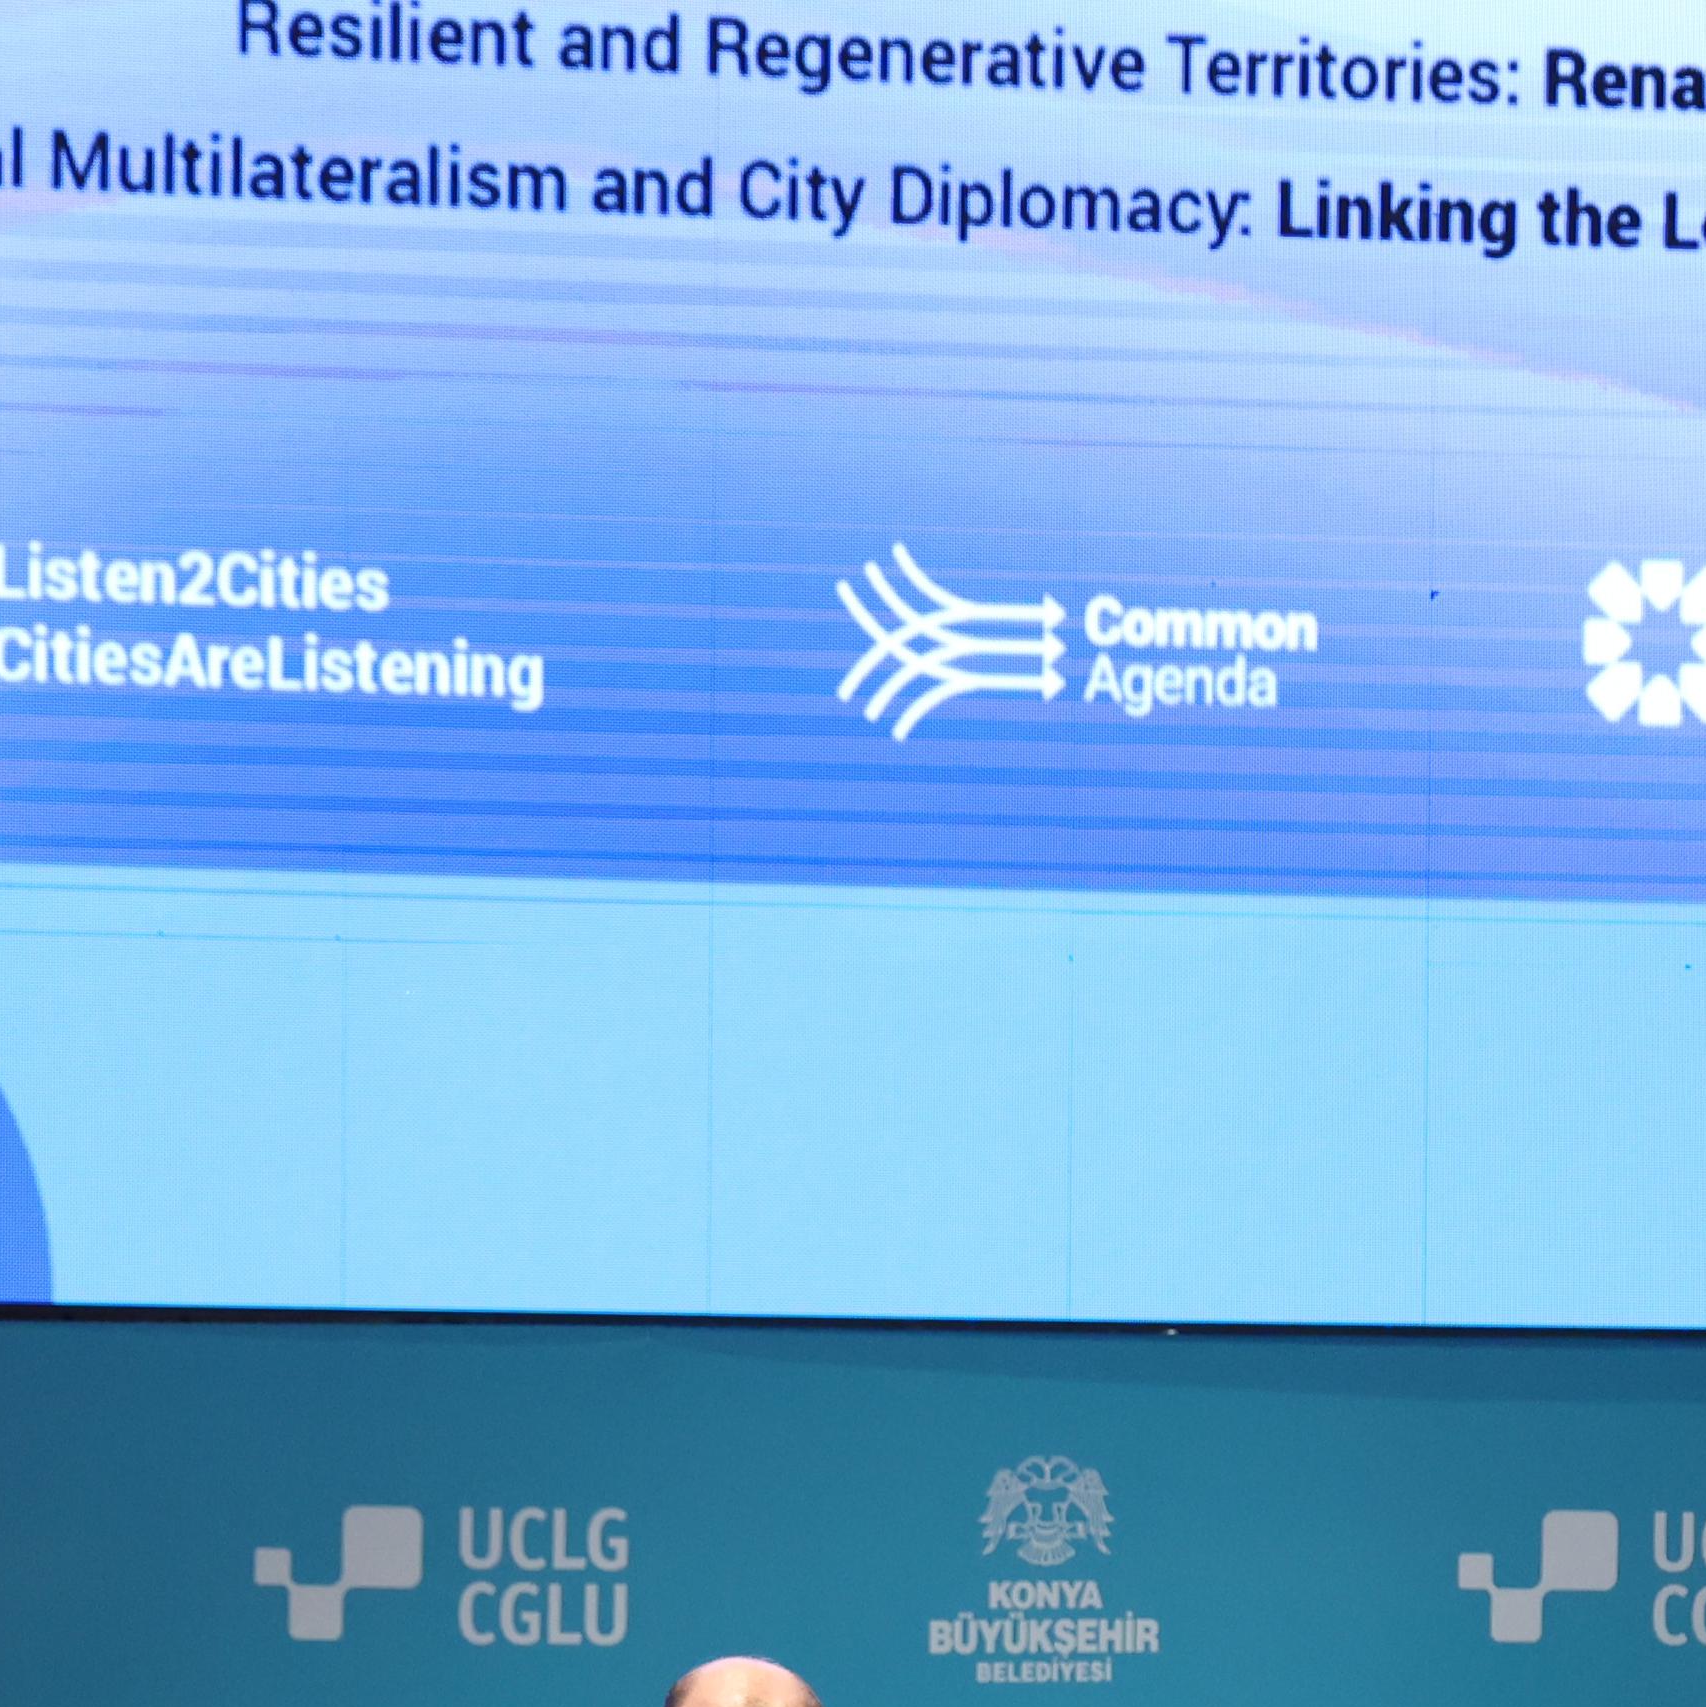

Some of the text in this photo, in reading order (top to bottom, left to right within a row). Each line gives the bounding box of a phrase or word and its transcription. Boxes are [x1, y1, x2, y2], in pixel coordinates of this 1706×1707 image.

[238, 0, 535, 69] Resilient
[557, 11, 681, 76] and
[706, 14, 1146, 97] Regenerative
[1166, 33, 1519, 107] Territories:
[50, 128, 568, 212] Multilateralism
[591, 154, 714, 218] and
[738, 158, 866, 240] City
[890, 162, 1252, 252] Diplomacy:
[1278, 177, 1518, 260] Linking
[1535, 185, 1643, 249] the
[1083, 593, 1320, 653] Common
[1082, 651, 1279, 720] Agenda
[459, 1506, 630, 1572] UCLG
[458, 1580, 629, 1647] CGLU
[988, 1580, 1104, 1611] KONYA
[927, 1609, 1161, 1658] BÜYÜKŞEHİR
[975, 1656, 1113, 1684] BELEDİYESİ
